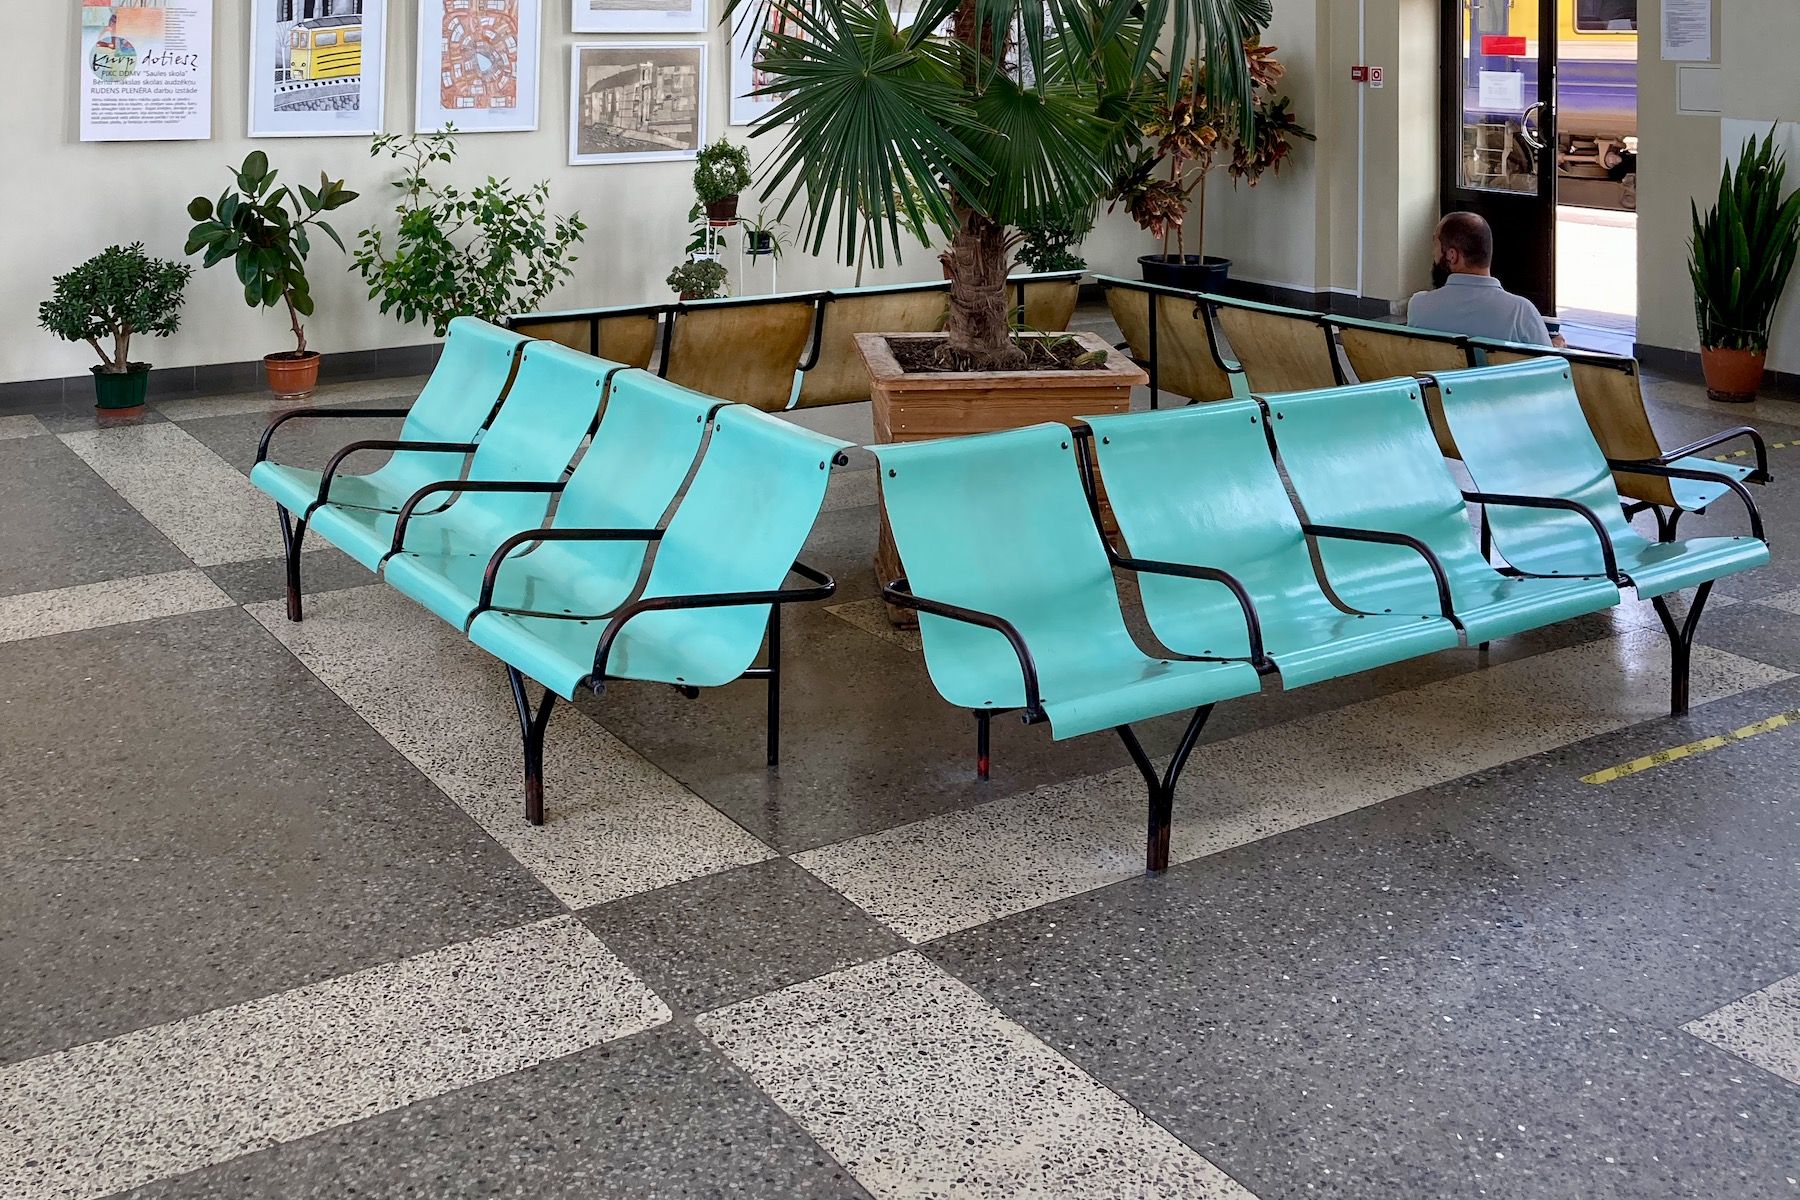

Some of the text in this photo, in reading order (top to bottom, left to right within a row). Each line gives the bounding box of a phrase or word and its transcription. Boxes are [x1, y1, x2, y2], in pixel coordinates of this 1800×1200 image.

[92, 49, 198, 71] Kurp doties?
[121, 86, 152, 94] PLENĒRA
[174, 86, 198, 94] izstāde
